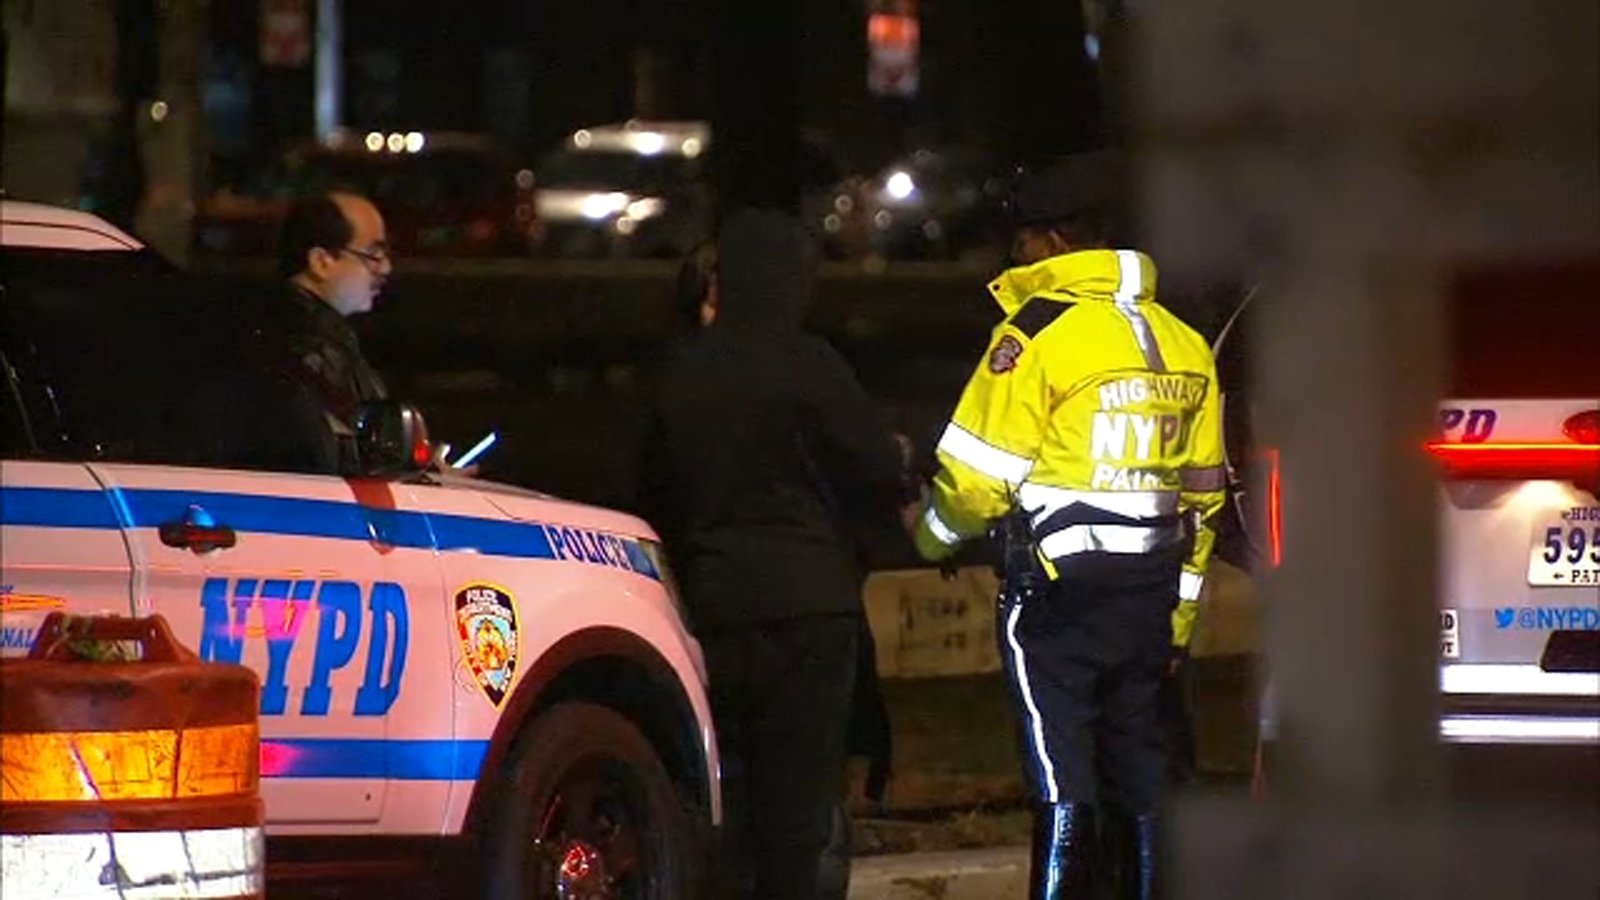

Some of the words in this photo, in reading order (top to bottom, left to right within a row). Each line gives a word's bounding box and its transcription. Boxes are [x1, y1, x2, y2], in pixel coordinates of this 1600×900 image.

[1091, 412, 1191, 460] NYPD
[545, 525, 632, 571] POLICE
[200, 578, 408, 715] NYPD
